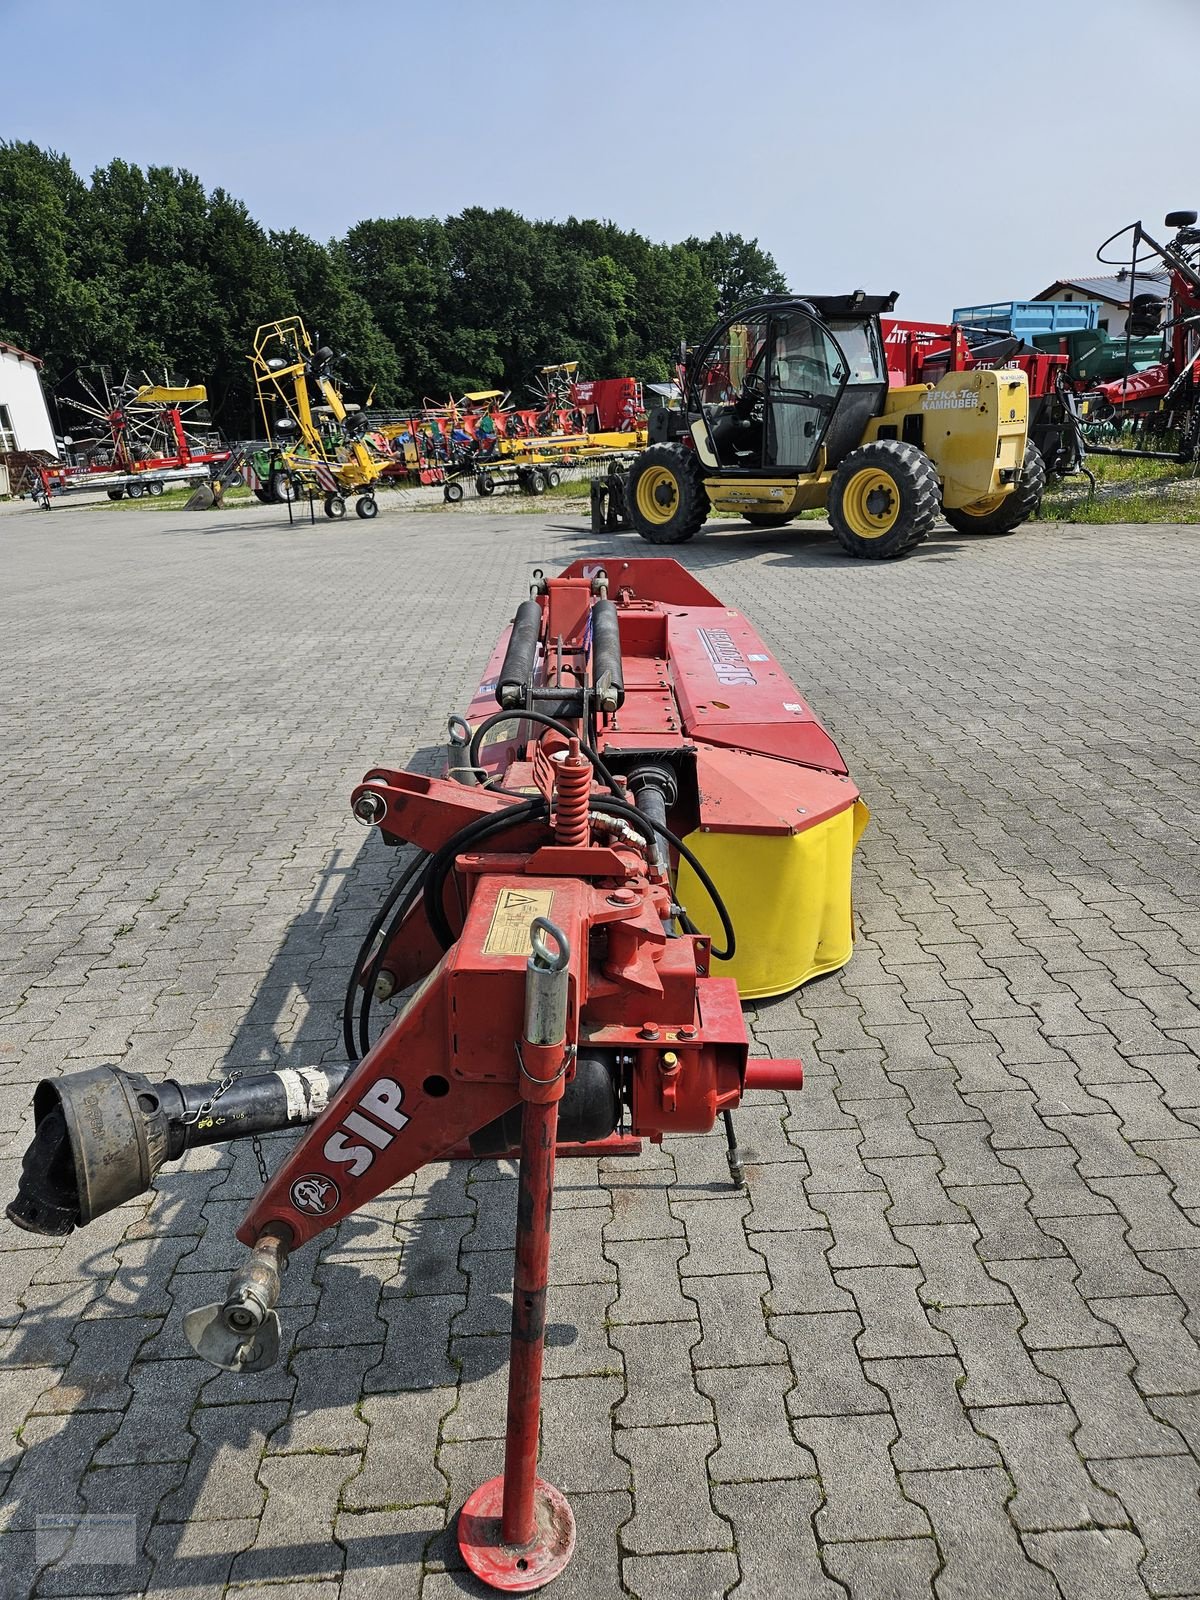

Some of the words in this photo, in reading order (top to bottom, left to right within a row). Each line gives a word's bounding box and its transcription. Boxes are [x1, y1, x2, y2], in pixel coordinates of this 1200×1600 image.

[922, 398, 978, 410] KAMHUBER
[713, 663, 757, 686] SIP
[323, 1077, 411, 1177] SIP
